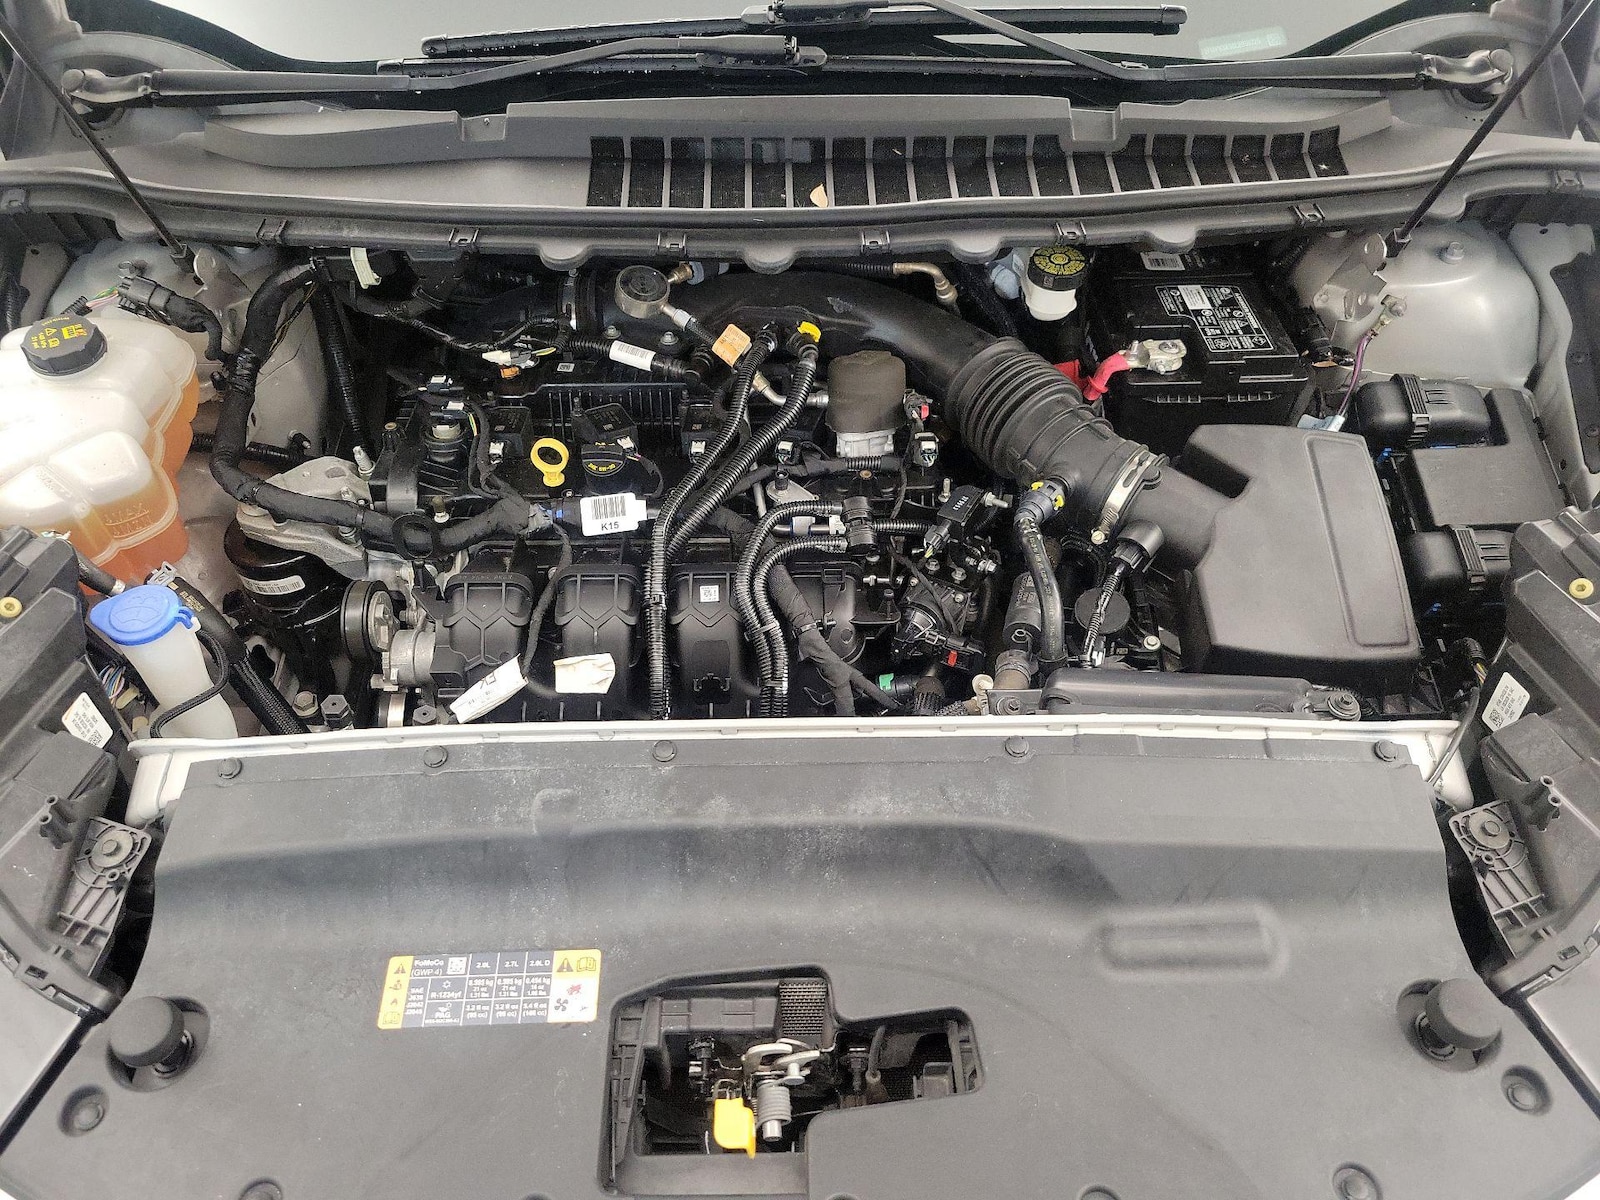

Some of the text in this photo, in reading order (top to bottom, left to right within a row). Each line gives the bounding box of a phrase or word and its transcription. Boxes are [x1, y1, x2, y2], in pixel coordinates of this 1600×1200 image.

[601, 521, 620, 532] K15
[414, 958, 444, 967] FoMoCo
[411, 968, 442, 977] (GWP 4)
[431, 991, 462, 999] R-1234yf
